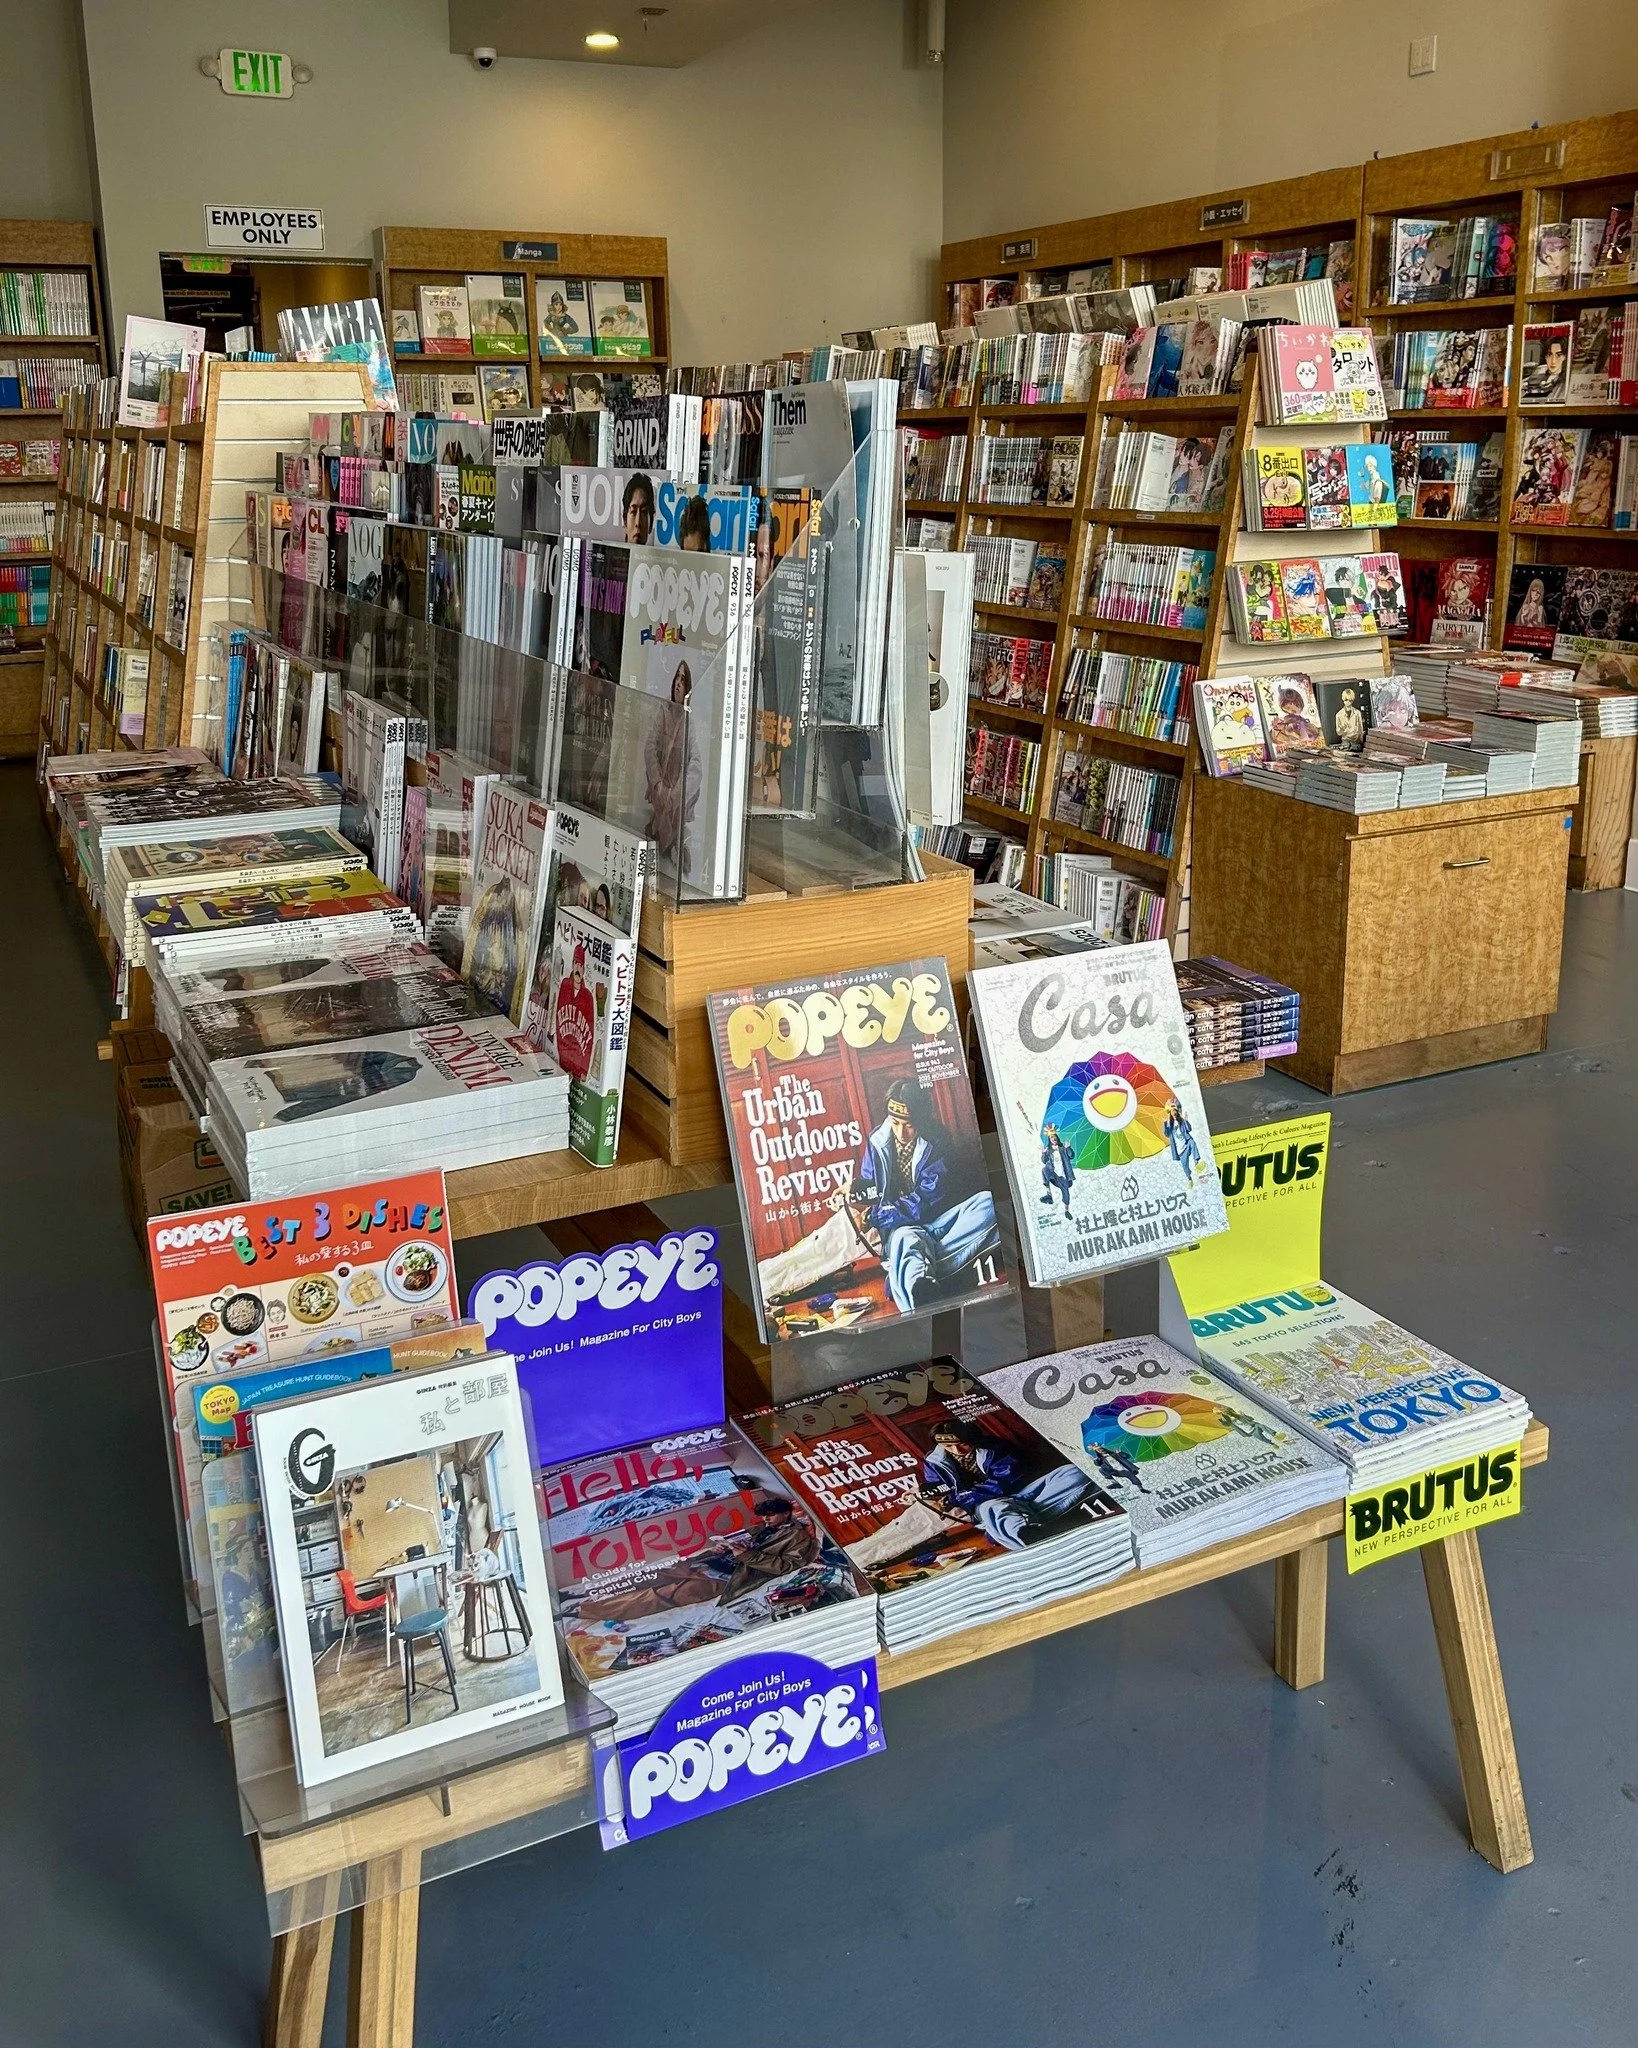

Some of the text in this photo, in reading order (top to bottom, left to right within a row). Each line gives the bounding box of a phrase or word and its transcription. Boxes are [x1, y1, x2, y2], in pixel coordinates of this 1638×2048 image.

[232, 51, 283, 94] EXIT
[211, 210, 318, 229] EMPLOYEES
[242, 228, 292, 245] ONLY
[516, 247, 543, 258] Manga
[290, 297, 384, 351] AKIRA
[1277, 332, 1331, 348] ちいかわ
[1332, 352, 1375, 374] タロット
[614, 418, 660, 456] GRIND
[1262, 454, 1299, 472] 8番出口
[751, 496, 760, 533] Safari
[810, 498, 821, 538] Safari
[562, 548, 570, 572] UOMO
[572, 548, 580, 572] UOMO
[730, 566, 739, 597] POPEYE
[744, 566, 753, 598] POPEYE
[629, 561, 726, 637] POPEYE
[640, 622, 687, 647] PLAYFUL
[1436, 621, 1477, 634] FAIRY TAIL
[487, 791, 525, 844] SUKA
[555, 810, 580, 838] POPEYE
[483, 824, 535, 886] JACKET
[637, 848, 648, 877] POPEYE
[556, 919, 613, 968] ヘビトラ大図鑑
[609, 951, 631, 1052] ヘビトラ大図鑑
[1017, 972, 1161, 1054] Casa
[727, 973, 951, 1069] POPEYE
[416, 1024, 514, 1090] DENIM
[470, 1030, 524, 1070] VINTAGE
[911, 1038, 947, 1053] Magazine
[913, 1046, 955, 1060] for City Boys
[778, 1073, 812, 1096] The
[927, 1062, 954, 1074] OUTDOOR
[931, 1068, 960, 1081] NOVEMBER
[742, 1086, 827, 1129] Urban
[749, 1118, 863, 1168] Outdoors
[1225, 1120, 1327, 1147] Leading Lifestyle Culture Magazine
[756, 1154, 857, 1206] Review
[1273, 1181, 1318, 1198] FOR ALL
[167, 1184, 234, 1214] SAVE!
[1075, 1191, 1192, 1236] 村上隆と村上ハウス
[155, 1215, 249, 1252] POPEYE
[231, 1198, 445, 1266] BEST 3 DISHES
[1066, 1207, 1208, 1263] MURAKAMI HOUSE
[294, 1239, 375, 1267] 私の愛する3皿
[972, 1253, 1000, 1287] 11
[474, 1231, 719, 1339] POPEYE
[528, 1310, 703, 1360] Join Us! Magazine For City Boys
[1232, 1313, 1346, 1348] 545 TOKYO SELECTIONS
[1098, 1348, 1145, 1365] BRUTUS
[241, 1373, 353, 1406] JAPAN TREASURE HUNT GUIDEBOOK
[416, 1385, 438, 1395] GINZA
[941, 1392, 978, 1406] Magazine
[971, 1394, 989, 1405] Boys
[1021, 1359, 1171, 1411] Casa
[1309, 1366, 1472, 1423] NEW PERSPECTIVE
[203, 1395, 236, 1410] TOKYO
[211, 1406, 232, 1417] Map
[752, 1364, 975, 1447] POPEYE
[1322, 1379, 1503, 1445] TOKYO
[651, 1427, 727, 1454] POPEYE
[782, 1440, 872, 1474] Urban
[816, 1438, 851, 1454] The
[542, 1451, 705, 1521] Hello,
[799, 1450, 919, 1494] Outdoors
[1154, 1455, 1313, 1521] MURAKAMI HOUSE
[1155, 1450, 1285, 1501] 村上隆と村上ハウス
[815, 1471, 922, 1516] Review
[1079, 1498, 1116, 1520] 11
[1349, 1452, 1518, 1543] BRUTUS
[552, 1489, 762, 1580] Tokyo!
[1353, 1495, 1513, 1557] NEW PERSPECTIVE FOR ALL
[584, 1555, 688, 1589] Exploring Japan's
[588, 1571, 659, 1597] Capital City
[591, 1567, 627, 1580] Guide
[627, 1560, 647, 1570] for
[675, 1676, 812, 1732] Magazine For City Boys
[700, 1669, 786, 1709] Come Join Us!
[492, 1700, 536, 1718] MAGAZINE HOUSE
[629, 1684, 862, 1819] POPEYE
